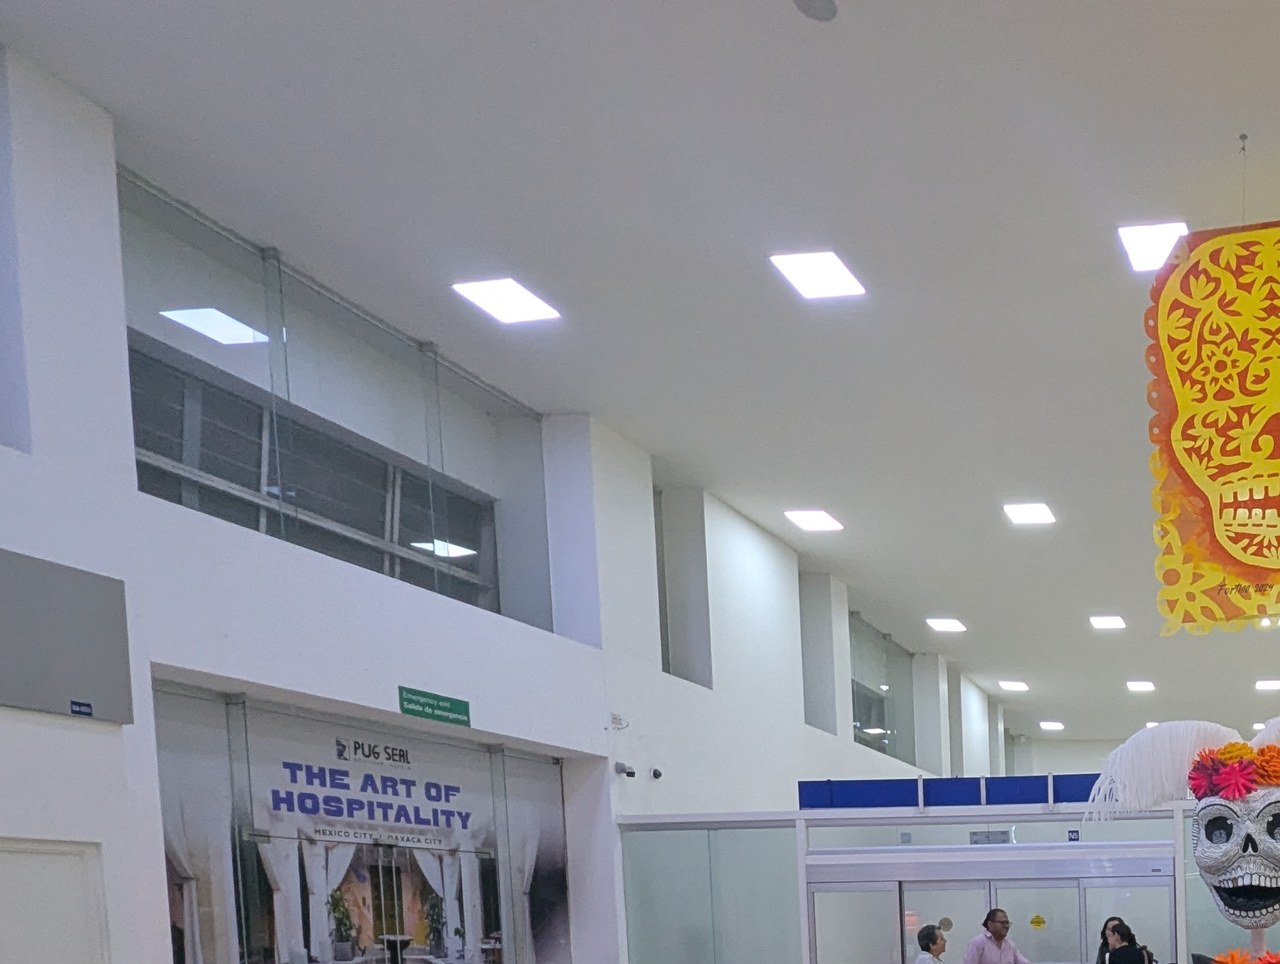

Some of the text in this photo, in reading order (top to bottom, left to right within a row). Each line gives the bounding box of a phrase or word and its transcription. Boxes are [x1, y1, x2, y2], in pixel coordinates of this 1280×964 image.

[403, 701, 423, 711] Salida
[434, 709, 468, 720] emergencia
[353, 740, 380, 760] PUG
[383, 745, 411, 764] SEAL
[282, 761, 350, 790] THE
[360, 773, 416, 799] ART
[424, 781, 461, 803] OF
[271, 789, 472, 830] HOSPITALITY
[314, 828, 442, 845] MEXICO CITY OAXACA CITY
